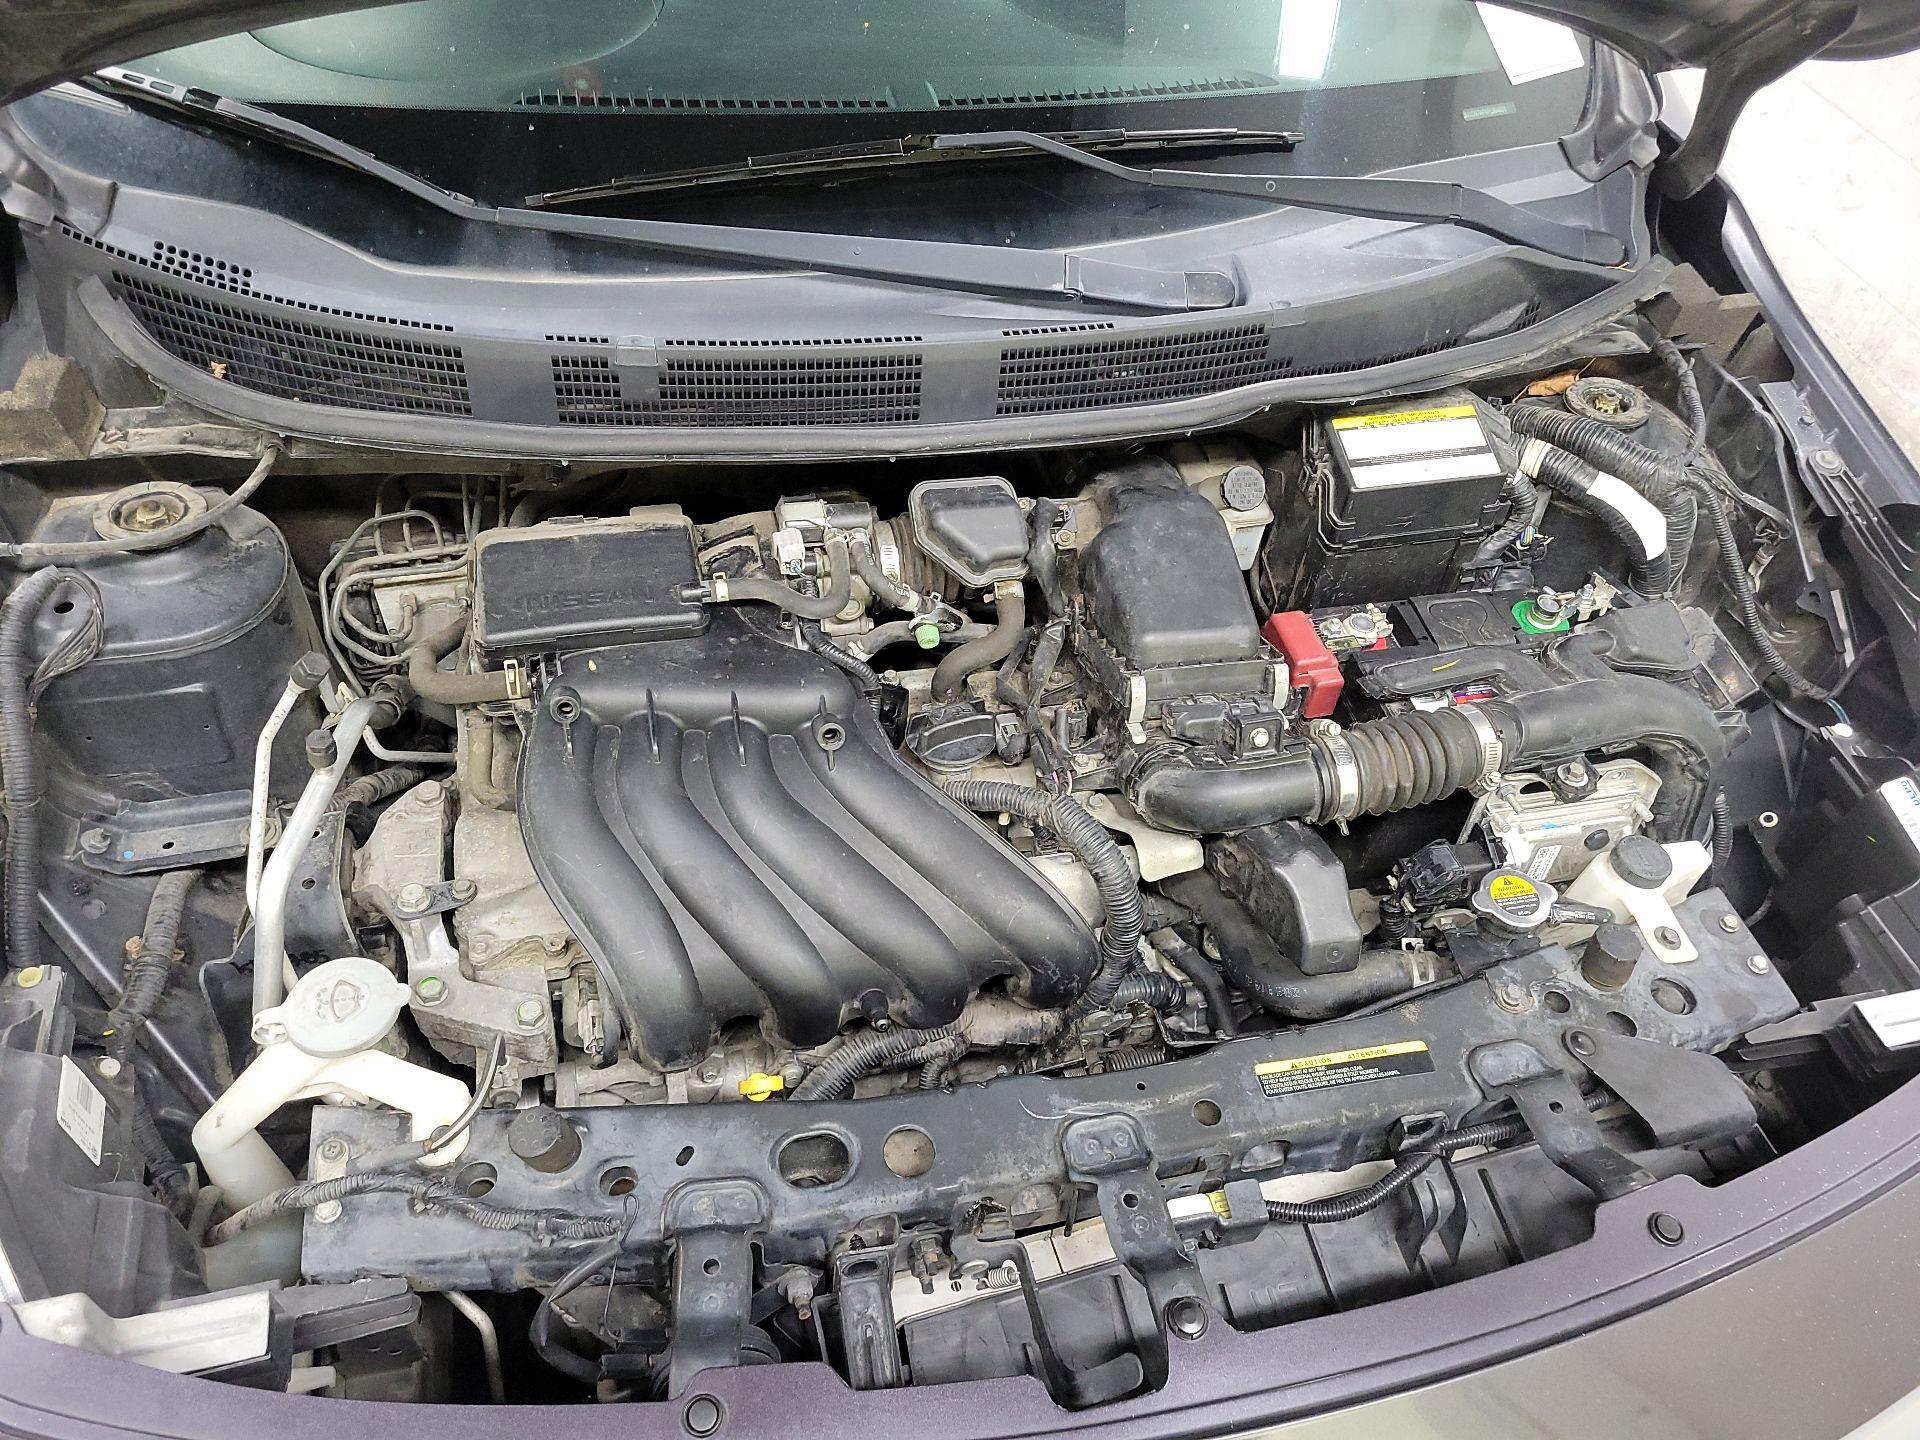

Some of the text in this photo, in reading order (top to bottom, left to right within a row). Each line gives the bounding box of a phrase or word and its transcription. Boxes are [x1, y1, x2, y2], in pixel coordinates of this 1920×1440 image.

[522, 583, 655, 616] NISSAN
[1298, 1057, 1332, 1066] CAUTION
[1348, 1049, 1388, 1059] ATTENTION
